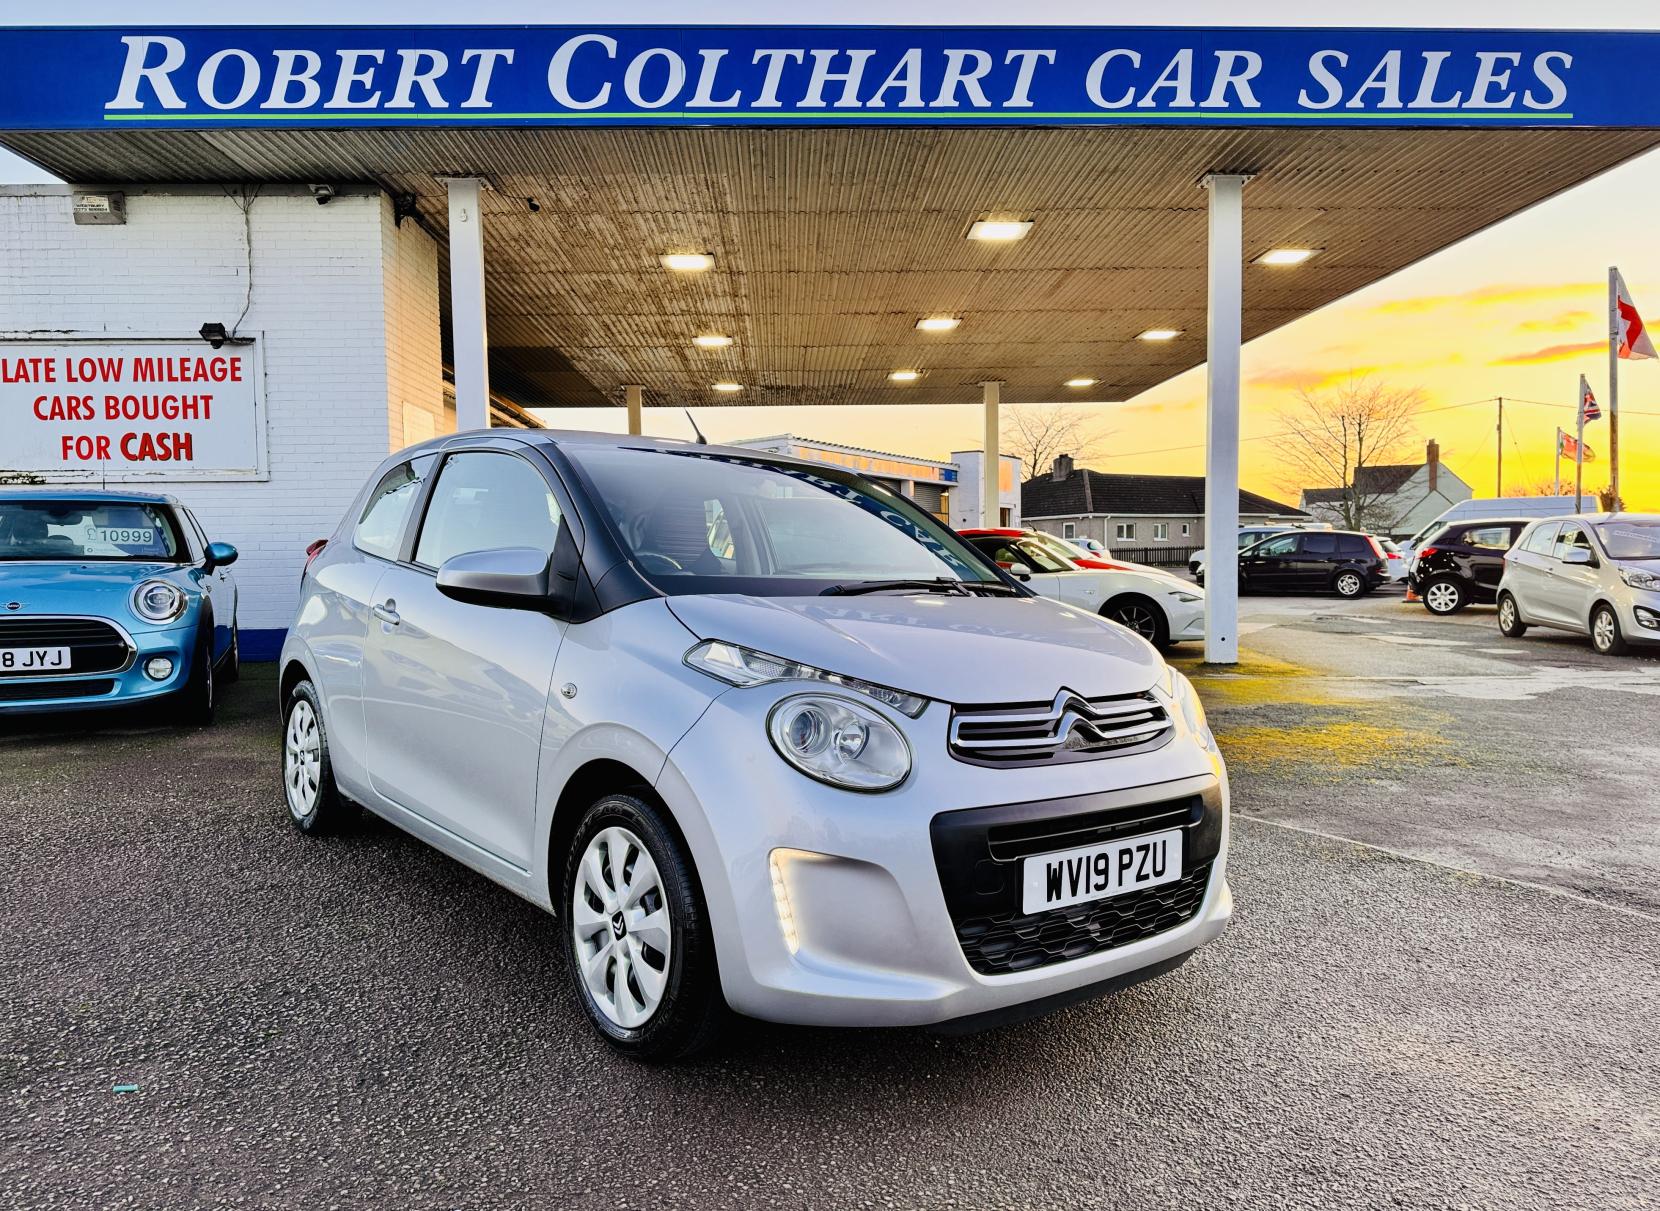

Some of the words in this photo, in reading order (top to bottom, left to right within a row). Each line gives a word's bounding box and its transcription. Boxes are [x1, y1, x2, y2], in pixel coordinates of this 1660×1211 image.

[104, 36, 515, 110] ROBERT
[547, 34, 1057, 110] COLTHART
[1086, 49, 1263, 109] CAR
[1297, 50, 1573, 110] SALES
[1, 358, 56, 383] LATE
[66, 358, 123, 383] LOW
[133, 357, 242, 383] MILEAGE
[33, 395, 95, 420] CARS
[105, 395, 213, 420] BOUGHT
[61, 436, 111, 460] FOR
[120, 432, 193, 461] CASH
[22, 650, 62, 667] JYJ
[1047, 853, 1109, 903] WV19
[1118, 840, 1166, 887] PZU
